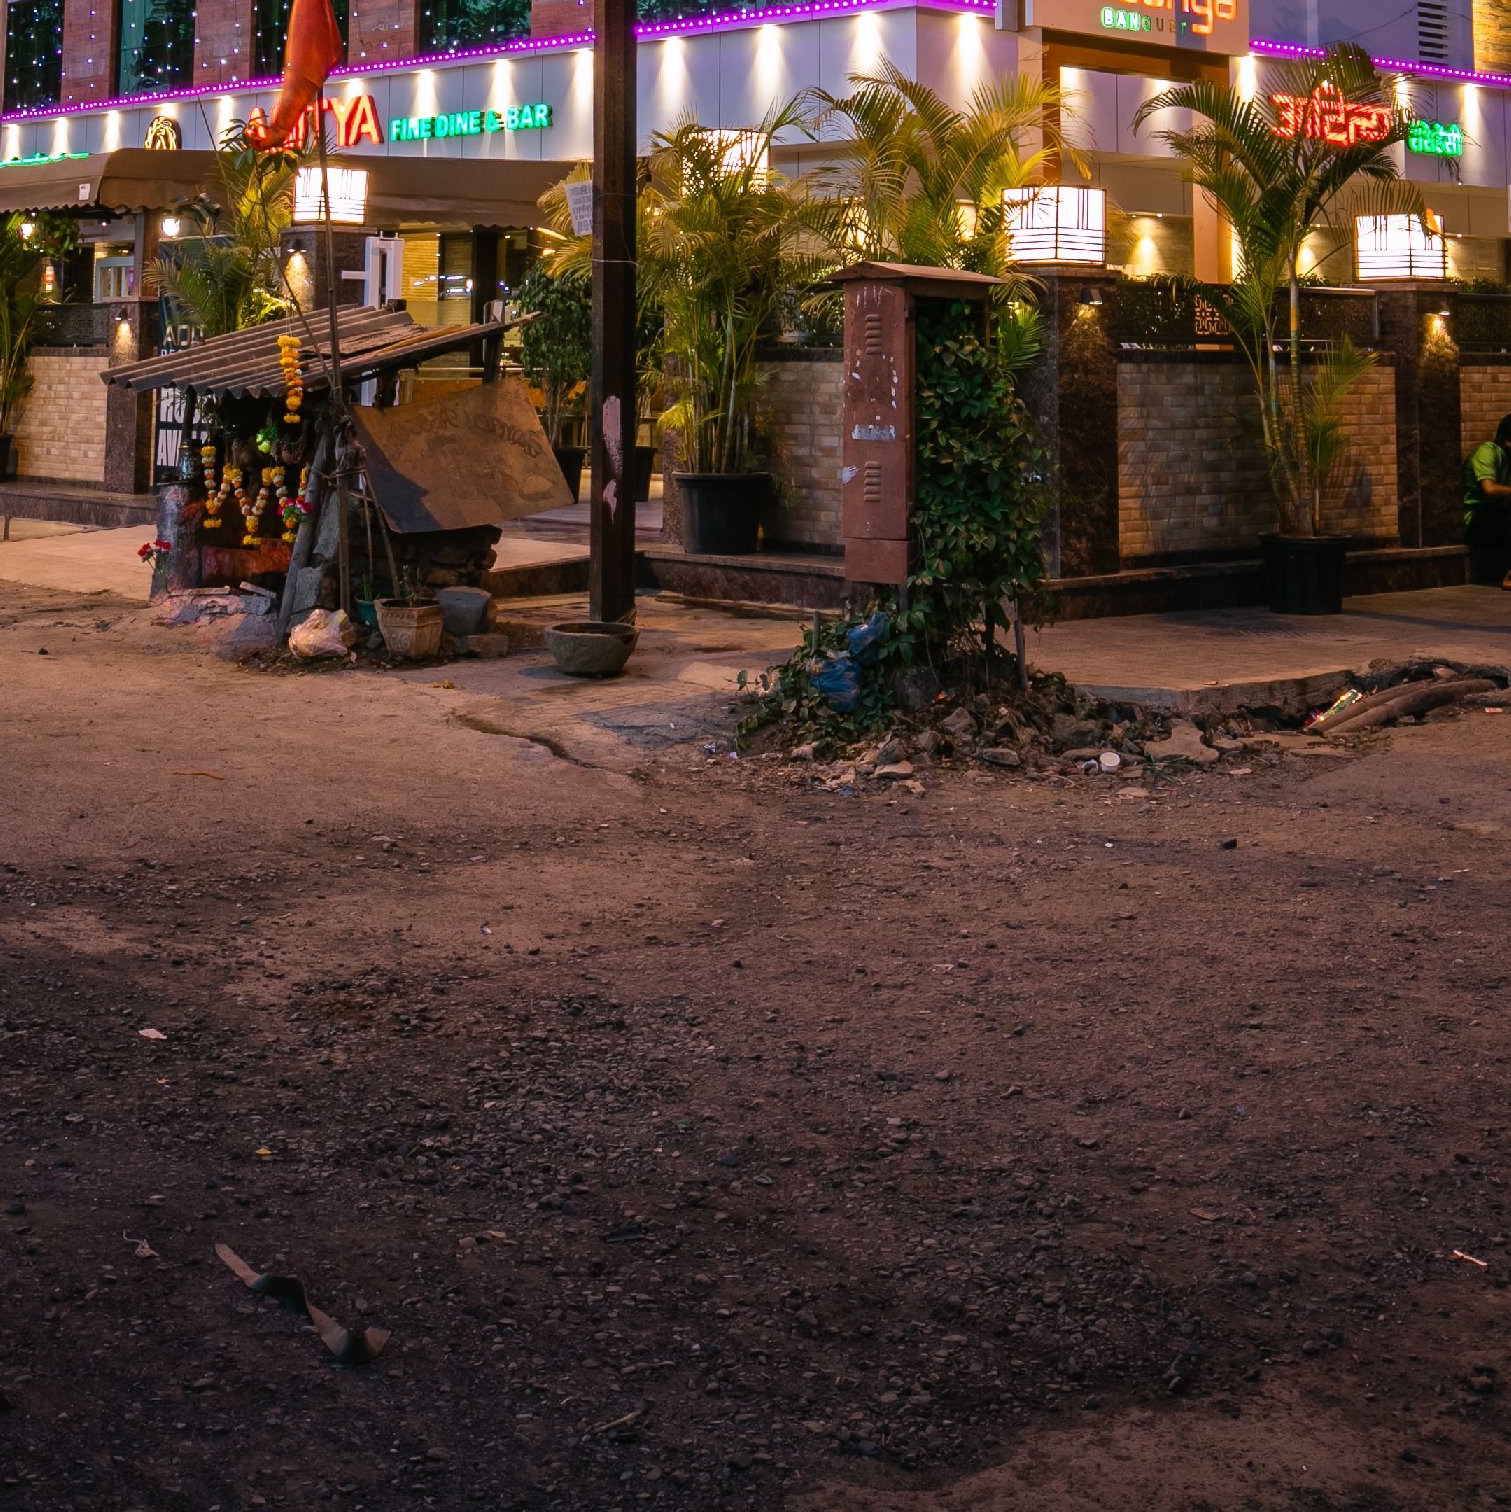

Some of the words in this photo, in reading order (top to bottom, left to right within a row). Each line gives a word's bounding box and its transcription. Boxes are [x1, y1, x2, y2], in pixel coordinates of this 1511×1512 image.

[390, 117, 433, 142] FINE
[434, 111, 483, 137] DINE
[506, 104, 550, 131] BAR
